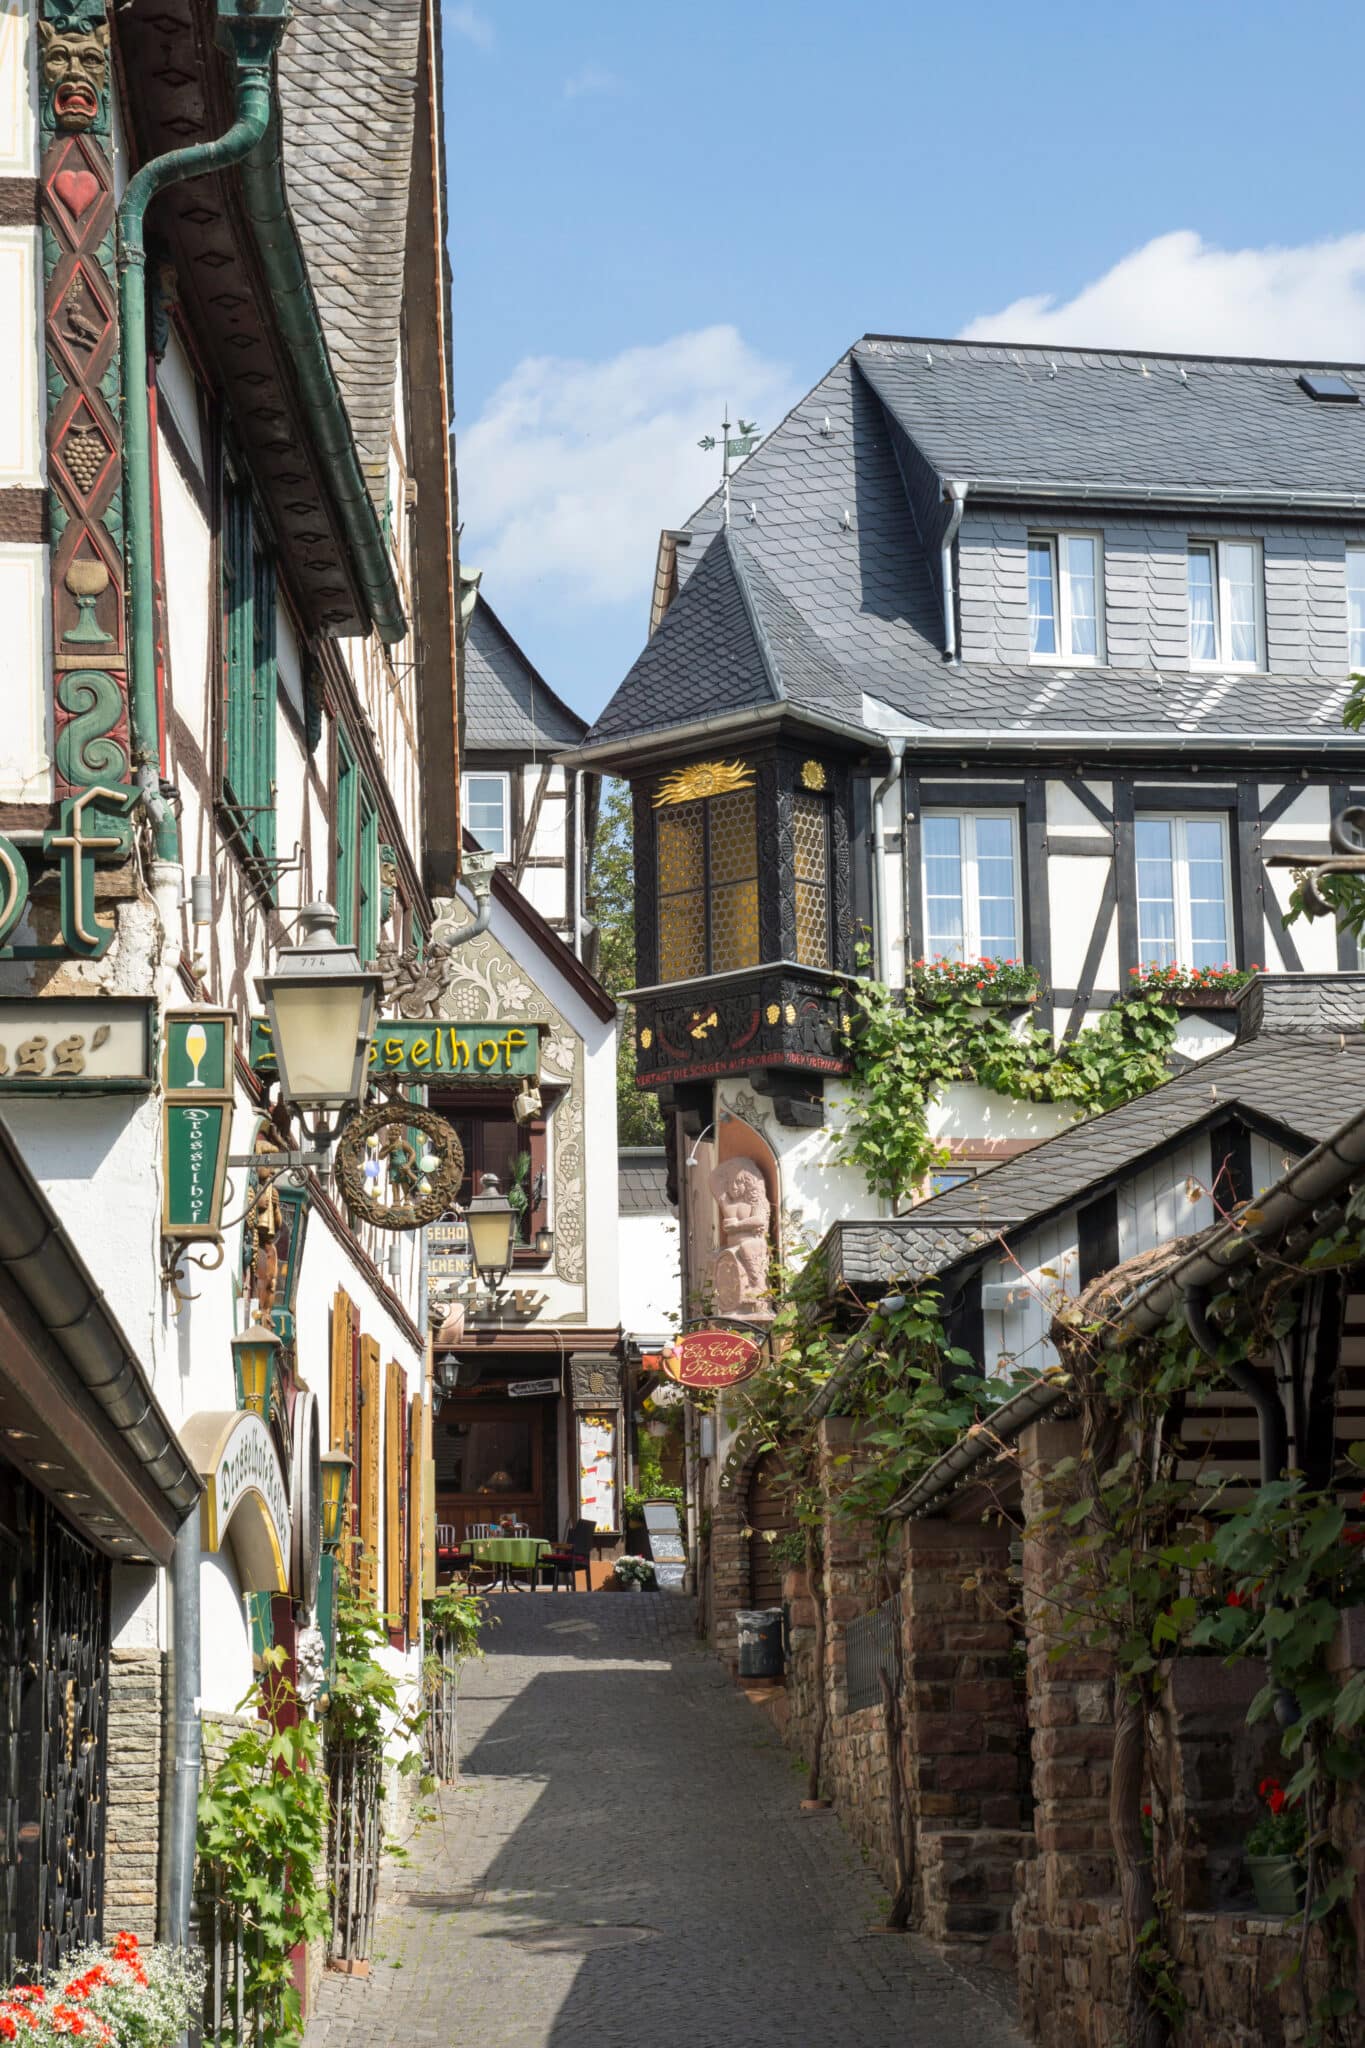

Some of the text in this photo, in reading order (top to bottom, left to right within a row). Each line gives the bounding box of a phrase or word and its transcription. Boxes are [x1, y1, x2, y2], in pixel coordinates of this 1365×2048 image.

[673, 1068, 688, 1080] DIE
[182, 1108, 209, 1223] Drosselhof
[427, 1226, 468, 1241] SELHO
[683, 1343, 707, 1359] Eis
